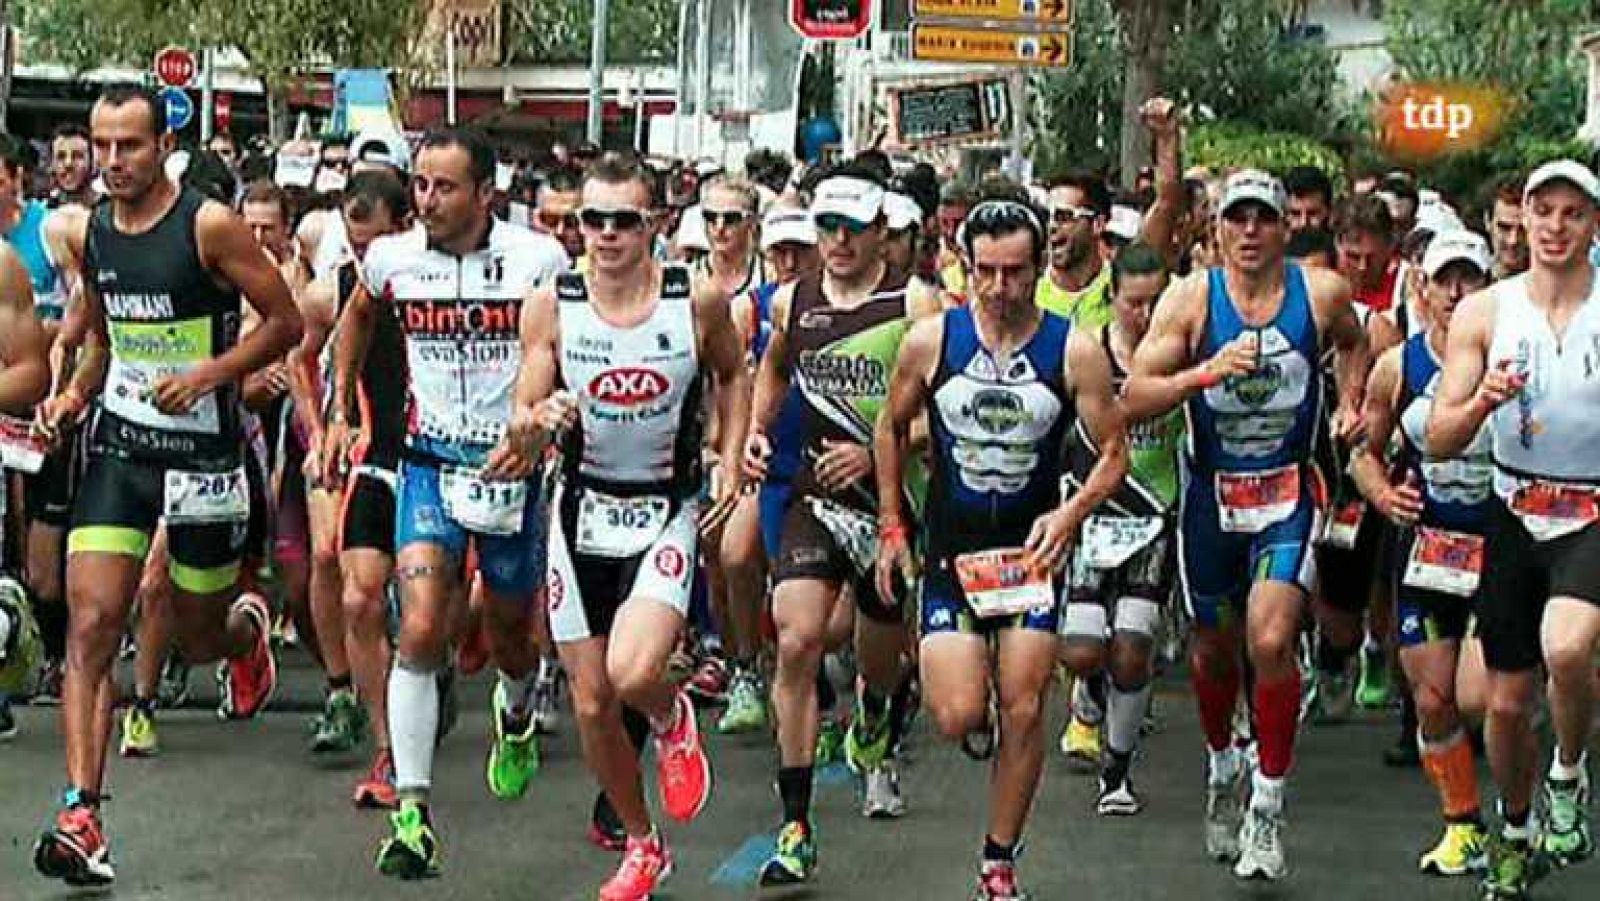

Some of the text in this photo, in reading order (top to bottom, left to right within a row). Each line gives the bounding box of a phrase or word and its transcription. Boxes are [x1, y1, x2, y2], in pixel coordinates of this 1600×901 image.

[597, 371, 662, 395] AXA
[467, 481, 512, 506] 311
[605, 507, 651, 529] 302
